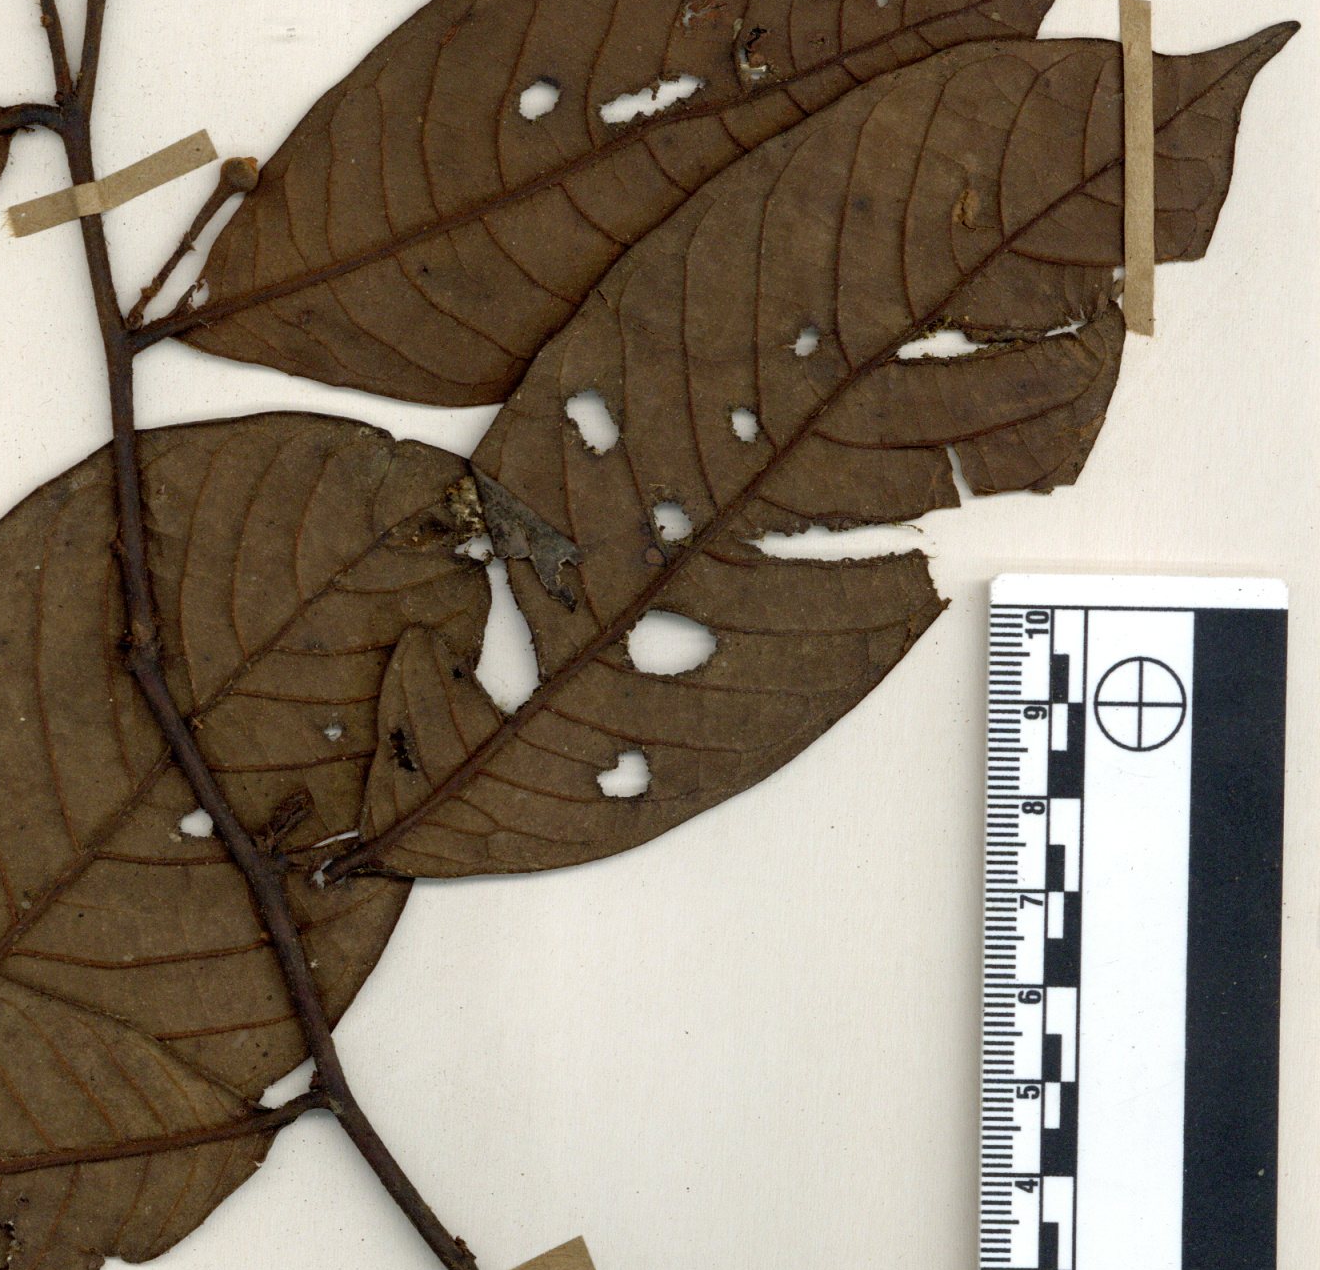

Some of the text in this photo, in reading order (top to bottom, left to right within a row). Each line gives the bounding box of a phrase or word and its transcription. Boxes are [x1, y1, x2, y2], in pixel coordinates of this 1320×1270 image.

[1026, 611, 1049, 638] 10
[1024, 706, 1047, 719] 9
[1022, 802, 1045, 814] 8
[1020, 895, 1043, 908] 7
[1018, 990, 1041, 1004] 6
[1017, 1086, 1040, 1099] 5
[1015, 1179, 1038, 1193] 4
